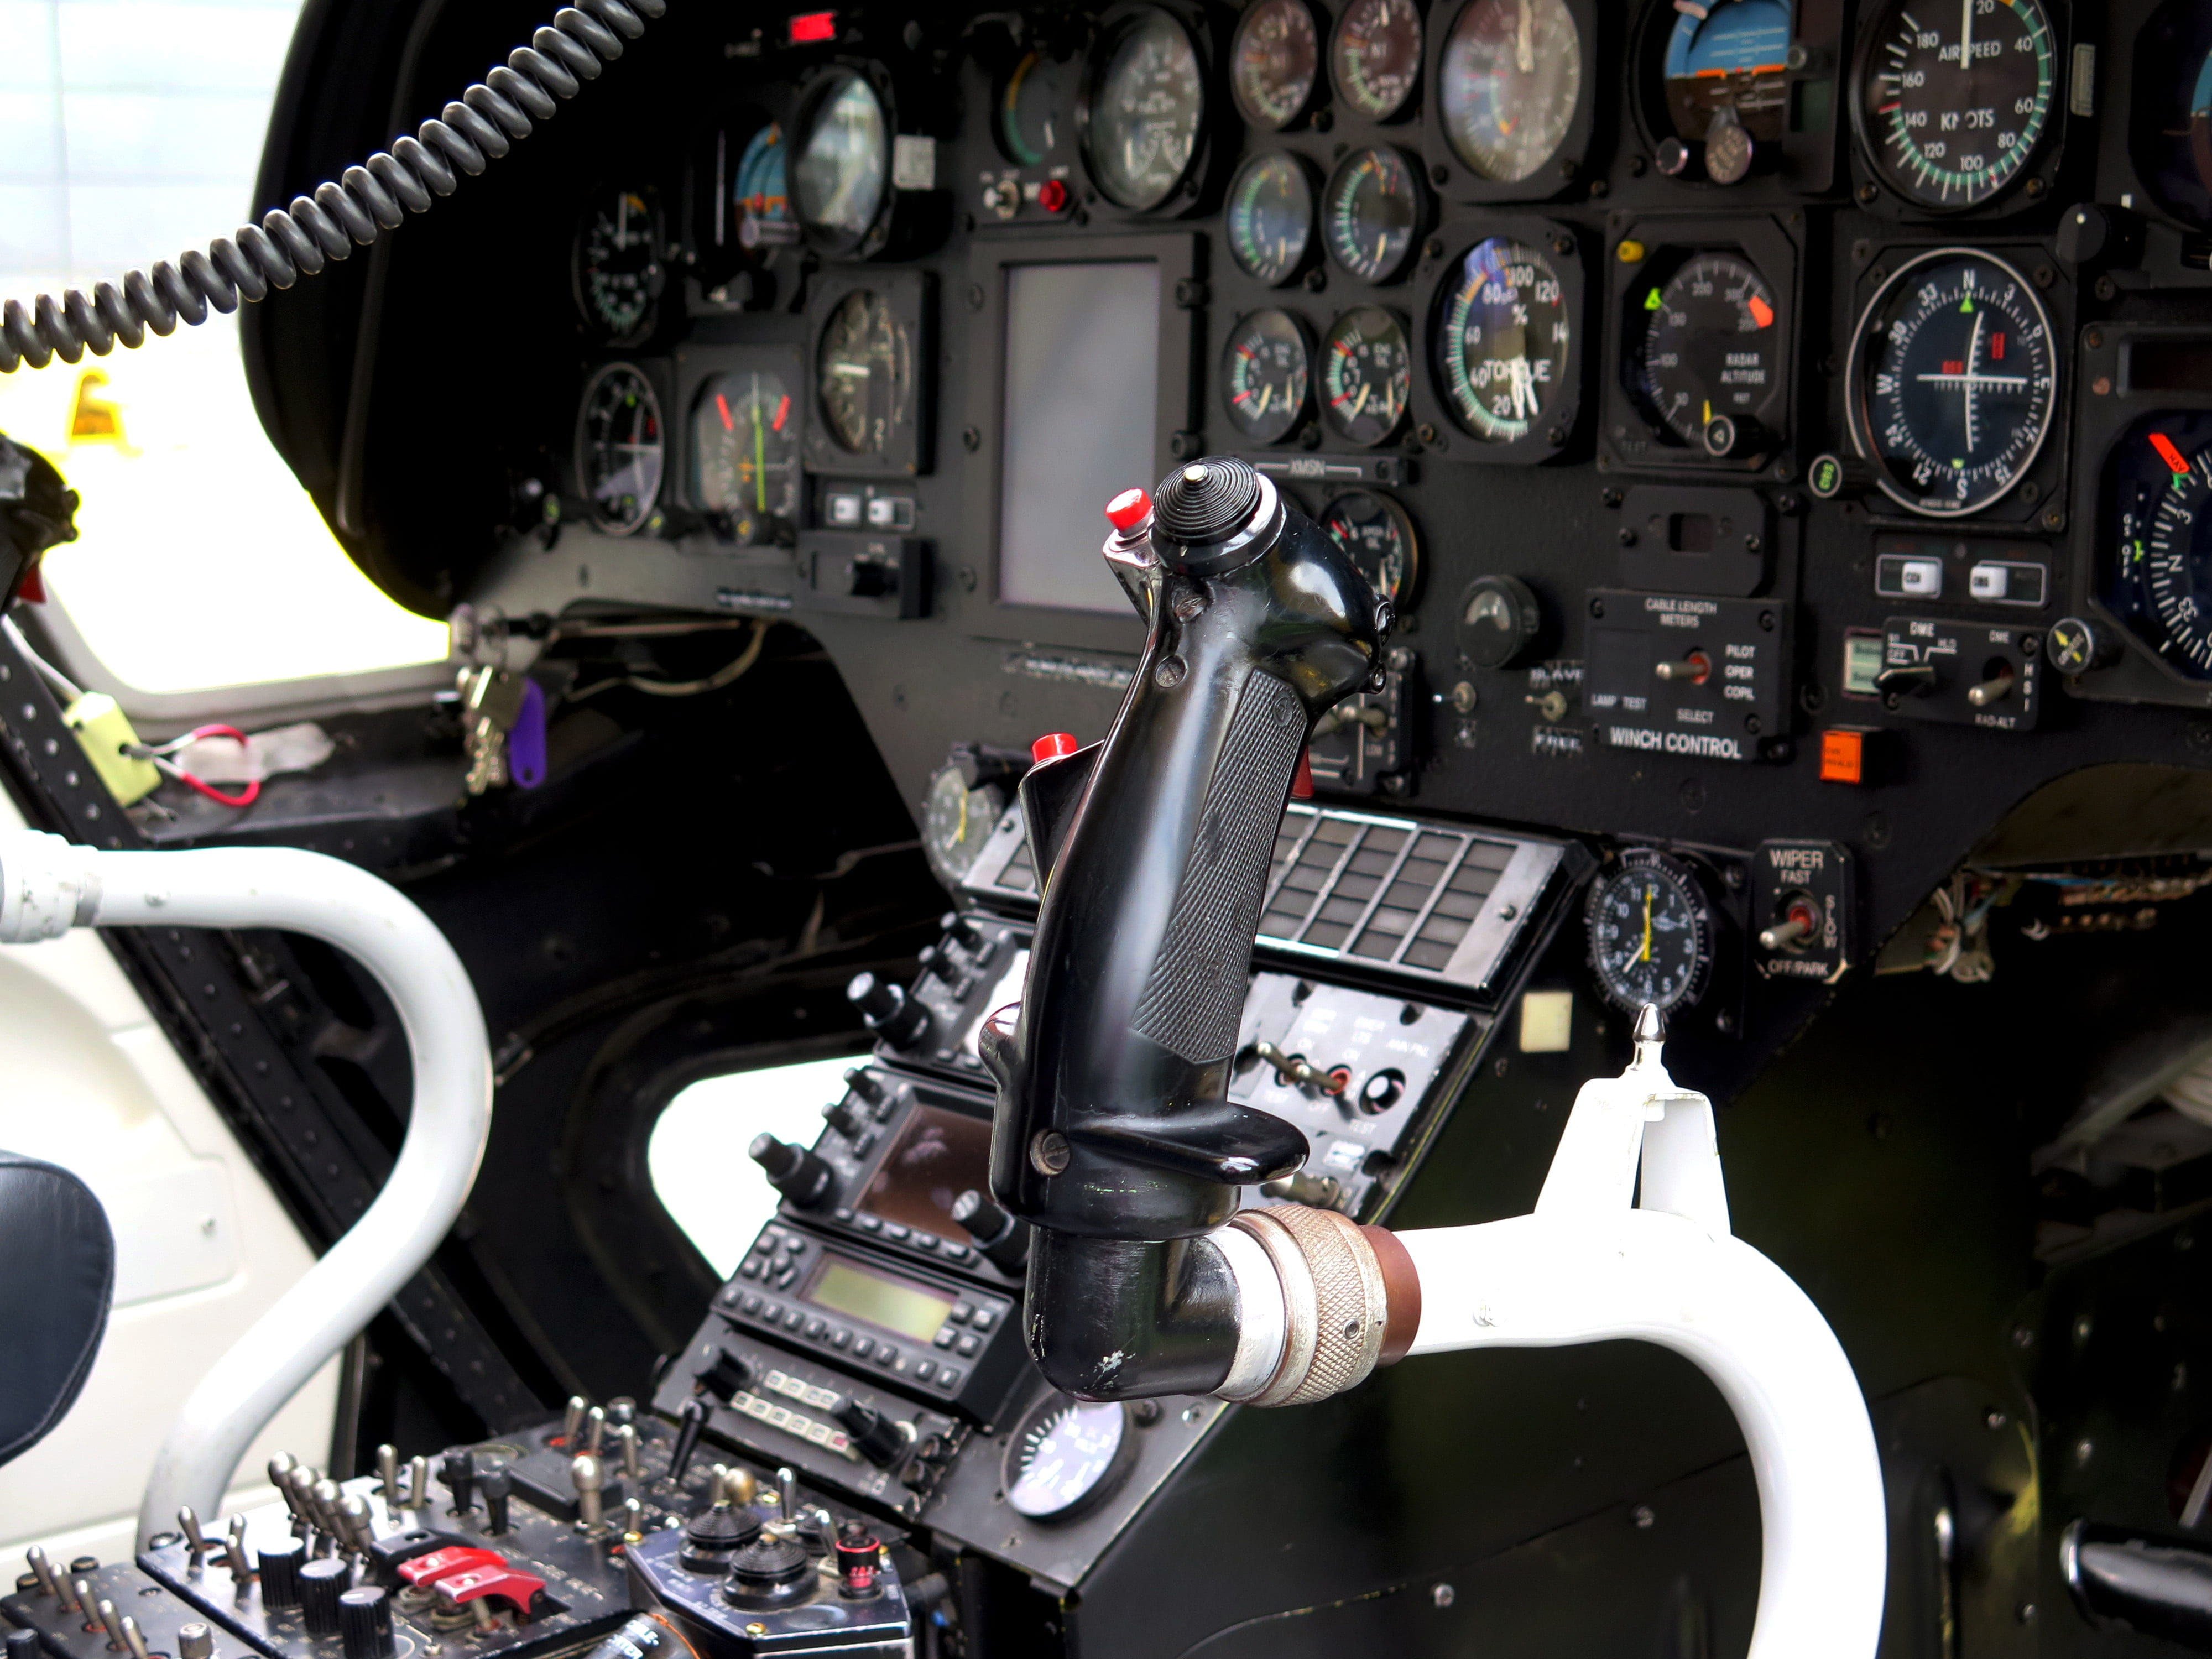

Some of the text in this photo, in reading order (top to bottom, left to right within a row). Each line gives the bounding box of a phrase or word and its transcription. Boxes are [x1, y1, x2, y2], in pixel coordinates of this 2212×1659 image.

[1976, 0, 1995, 14] 20
[1916, 30, 1939, 49] 180
[2014, 36, 2033, 53] 40
[1938, 40, 2002, 62] AIRPEED
[1902, 71, 1924, 88] 160
[2015, 97, 2035, 114] 60
[1904, 111, 1928, 128] 140
[1997, 132, 2016, 149] 80
[1923, 142, 1946, 159] 120
[1960, 155, 1984, 171] 100
[1510, 265, 1534, 288] 100
[1963, 269, 1975, 289] N
[1535, 280, 1559, 302] 120
[1918, 282, 1939, 307] 33
[2004, 284, 2017, 301] 3
[1464, 326, 1481, 345] 60
[1889, 320, 1908, 346] 30
[1725, 352, 1760, 367] RADAR
[1471, 366, 1488, 389] 40
[1720, 370, 1766, 384] ALTITUDE
[1876, 373, 1894, 395] W
[1491, 394, 1512, 416] 20
[1289, 458, 1326, 476] XMSN
[1912, 463, 1933, 486] 21
[1956, 478, 1968, 500] S
[2177, 508, 2192, 525] 3
[2167, 554, 2184, 572] N
[1645, 597, 1718, 615] CABLE LENGTH
[2178, 596, 2199, 623] 33
[1660, 613, 1700, 628] METERS
[1909, 621, 1936, 638] DME
[1725, 644, 1756, 659] PILOT
[1724, 664, 1754, 680] OPER
[1590, 693, 1647, 711] LAMP TEST
[1676, 707, 1715, 724] SELECT
[1609, 726, 1743, 760] WINCH CONTROL
[1768, 849, 1824, 870] WIPER
[1781, 870, 1812, 885] FAST
[1632, 887, 1641, 902] 11
[1668, 894, 1674, 909] 1
[1617, 903, 1629, 918] 10
[1676, 964, 1686, 976] 4
[1767, 959, 1829, 977] OFF/PARK
